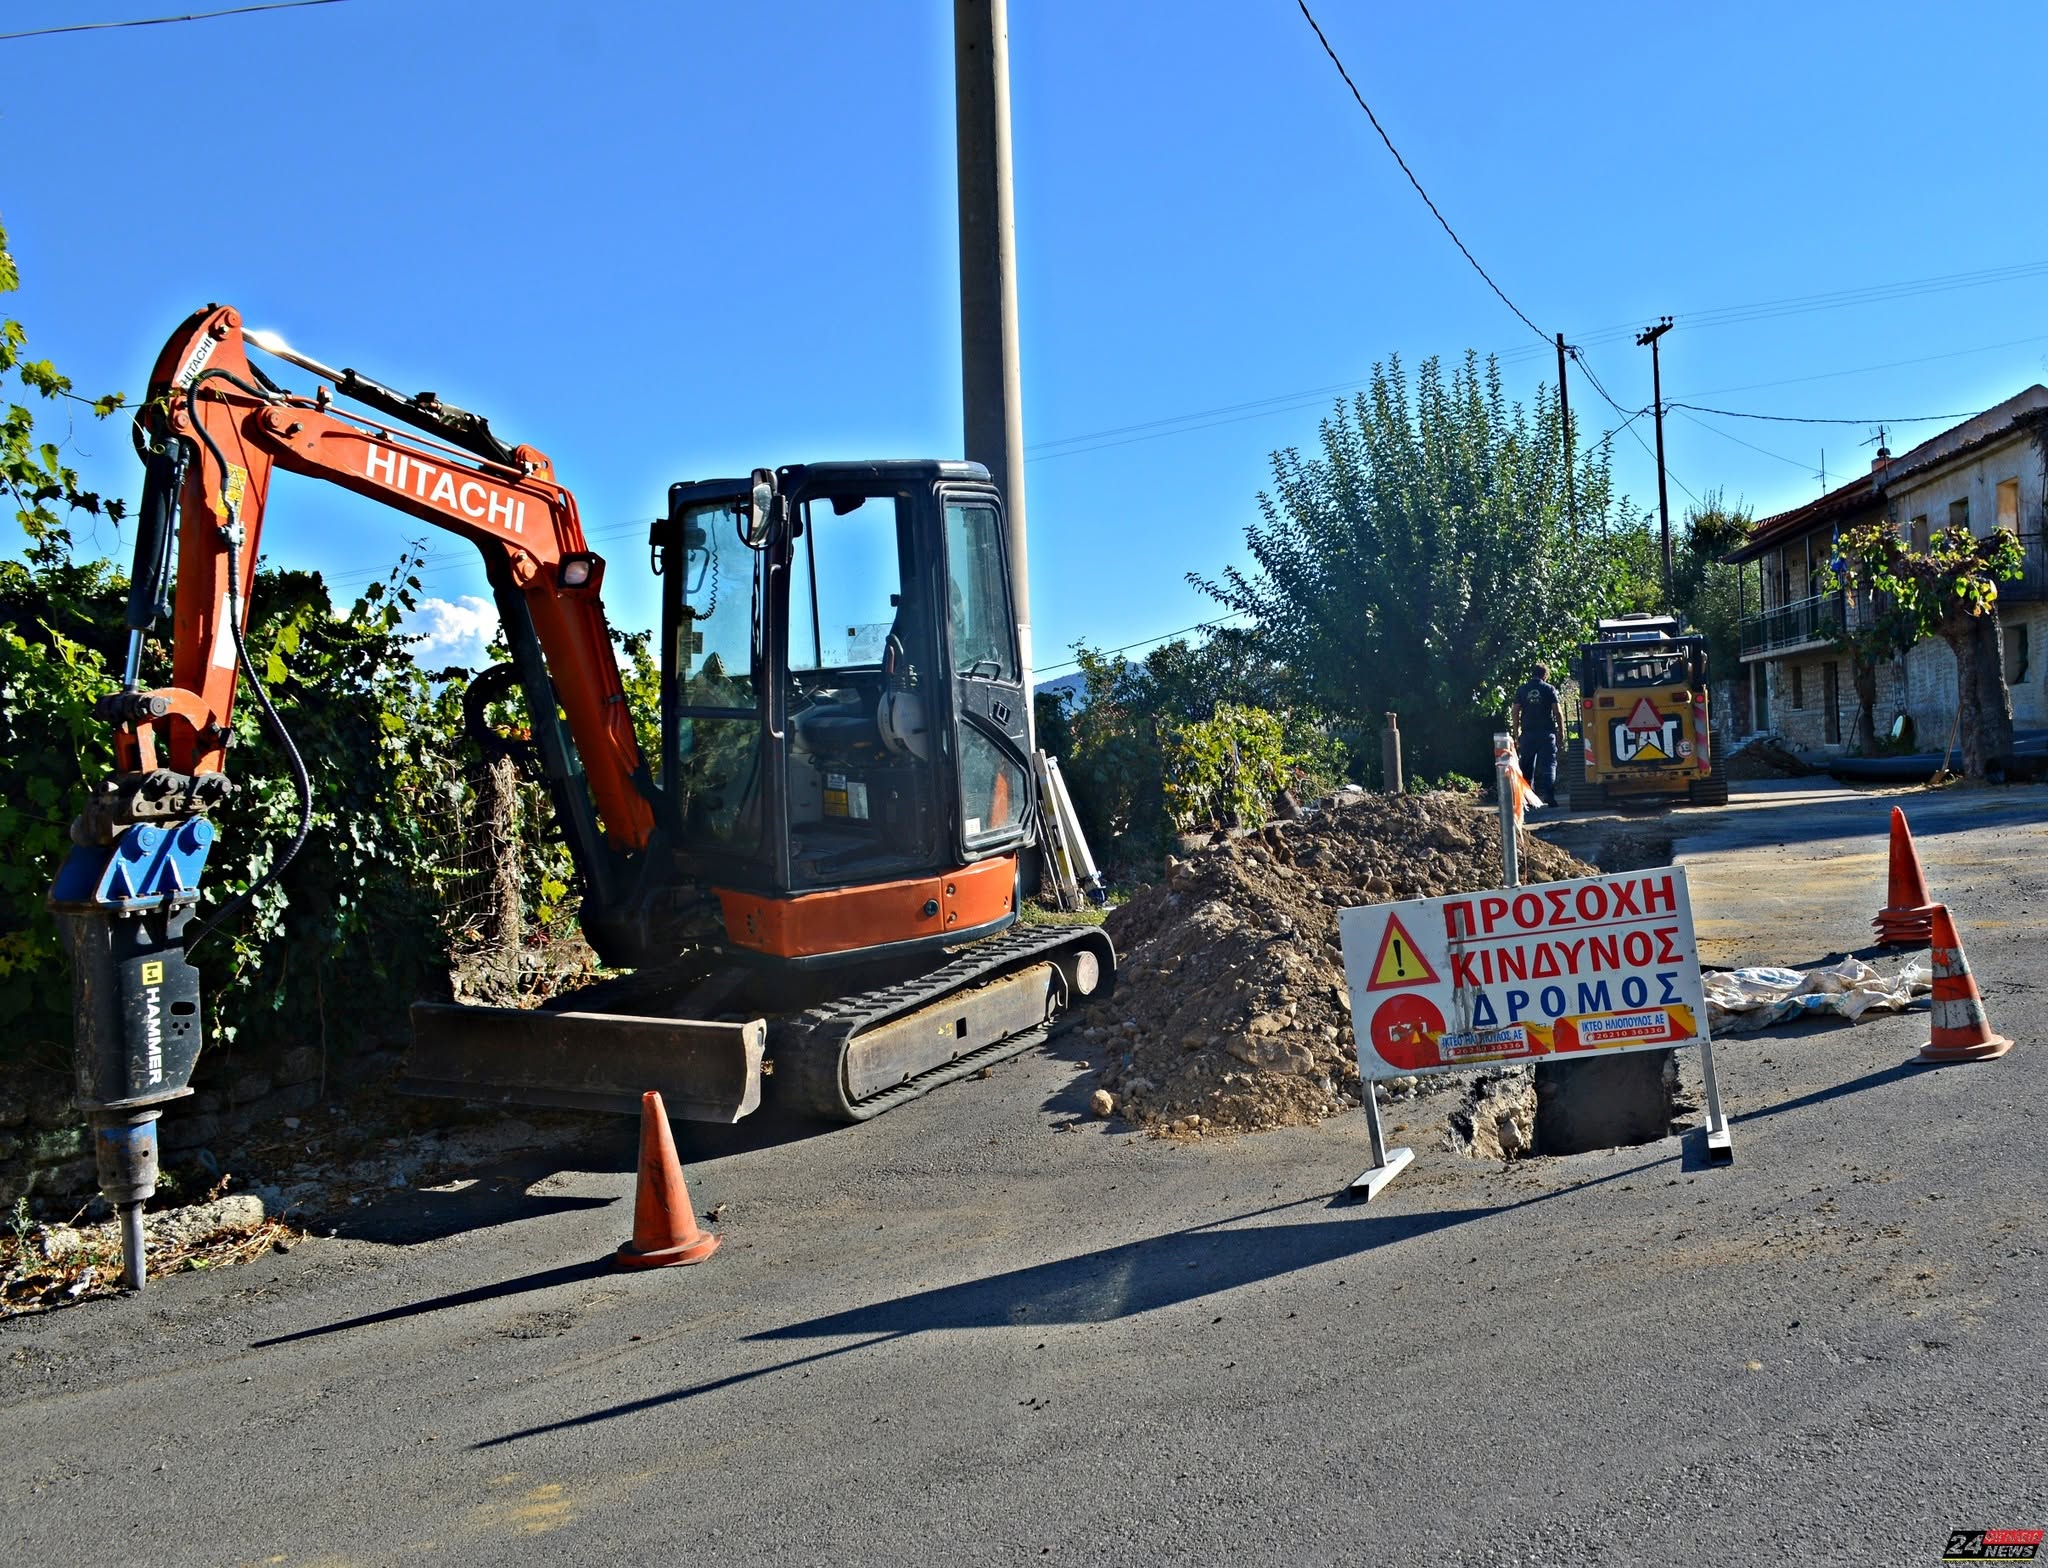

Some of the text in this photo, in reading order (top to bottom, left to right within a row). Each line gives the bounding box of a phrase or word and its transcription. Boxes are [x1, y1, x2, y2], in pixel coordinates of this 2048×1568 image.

[180, 338, 213, 386] HITACHI
[365, 442, 526, 534] HITACHI
[1615, 720, 1678, 761] CAT
[1443, 875, 1677, 939] ΠΡΟΣΟΧΗ
[1450, 927, 1684, 988] ΚΙΝΔΥΝΟΣ
[1472, 971, 1683, 1027] ΔΡΟΜΟΣ
[1581, 1020, 1603, 1033] ΙΚΤΕΟ
[1605, 1015, 1653, 1030] ΗΛΙΟΠΟΥΛΟΣ
[146, 987, 162, 1086] HAMMER
[1596, 1031, 1628, 1040] 26210
